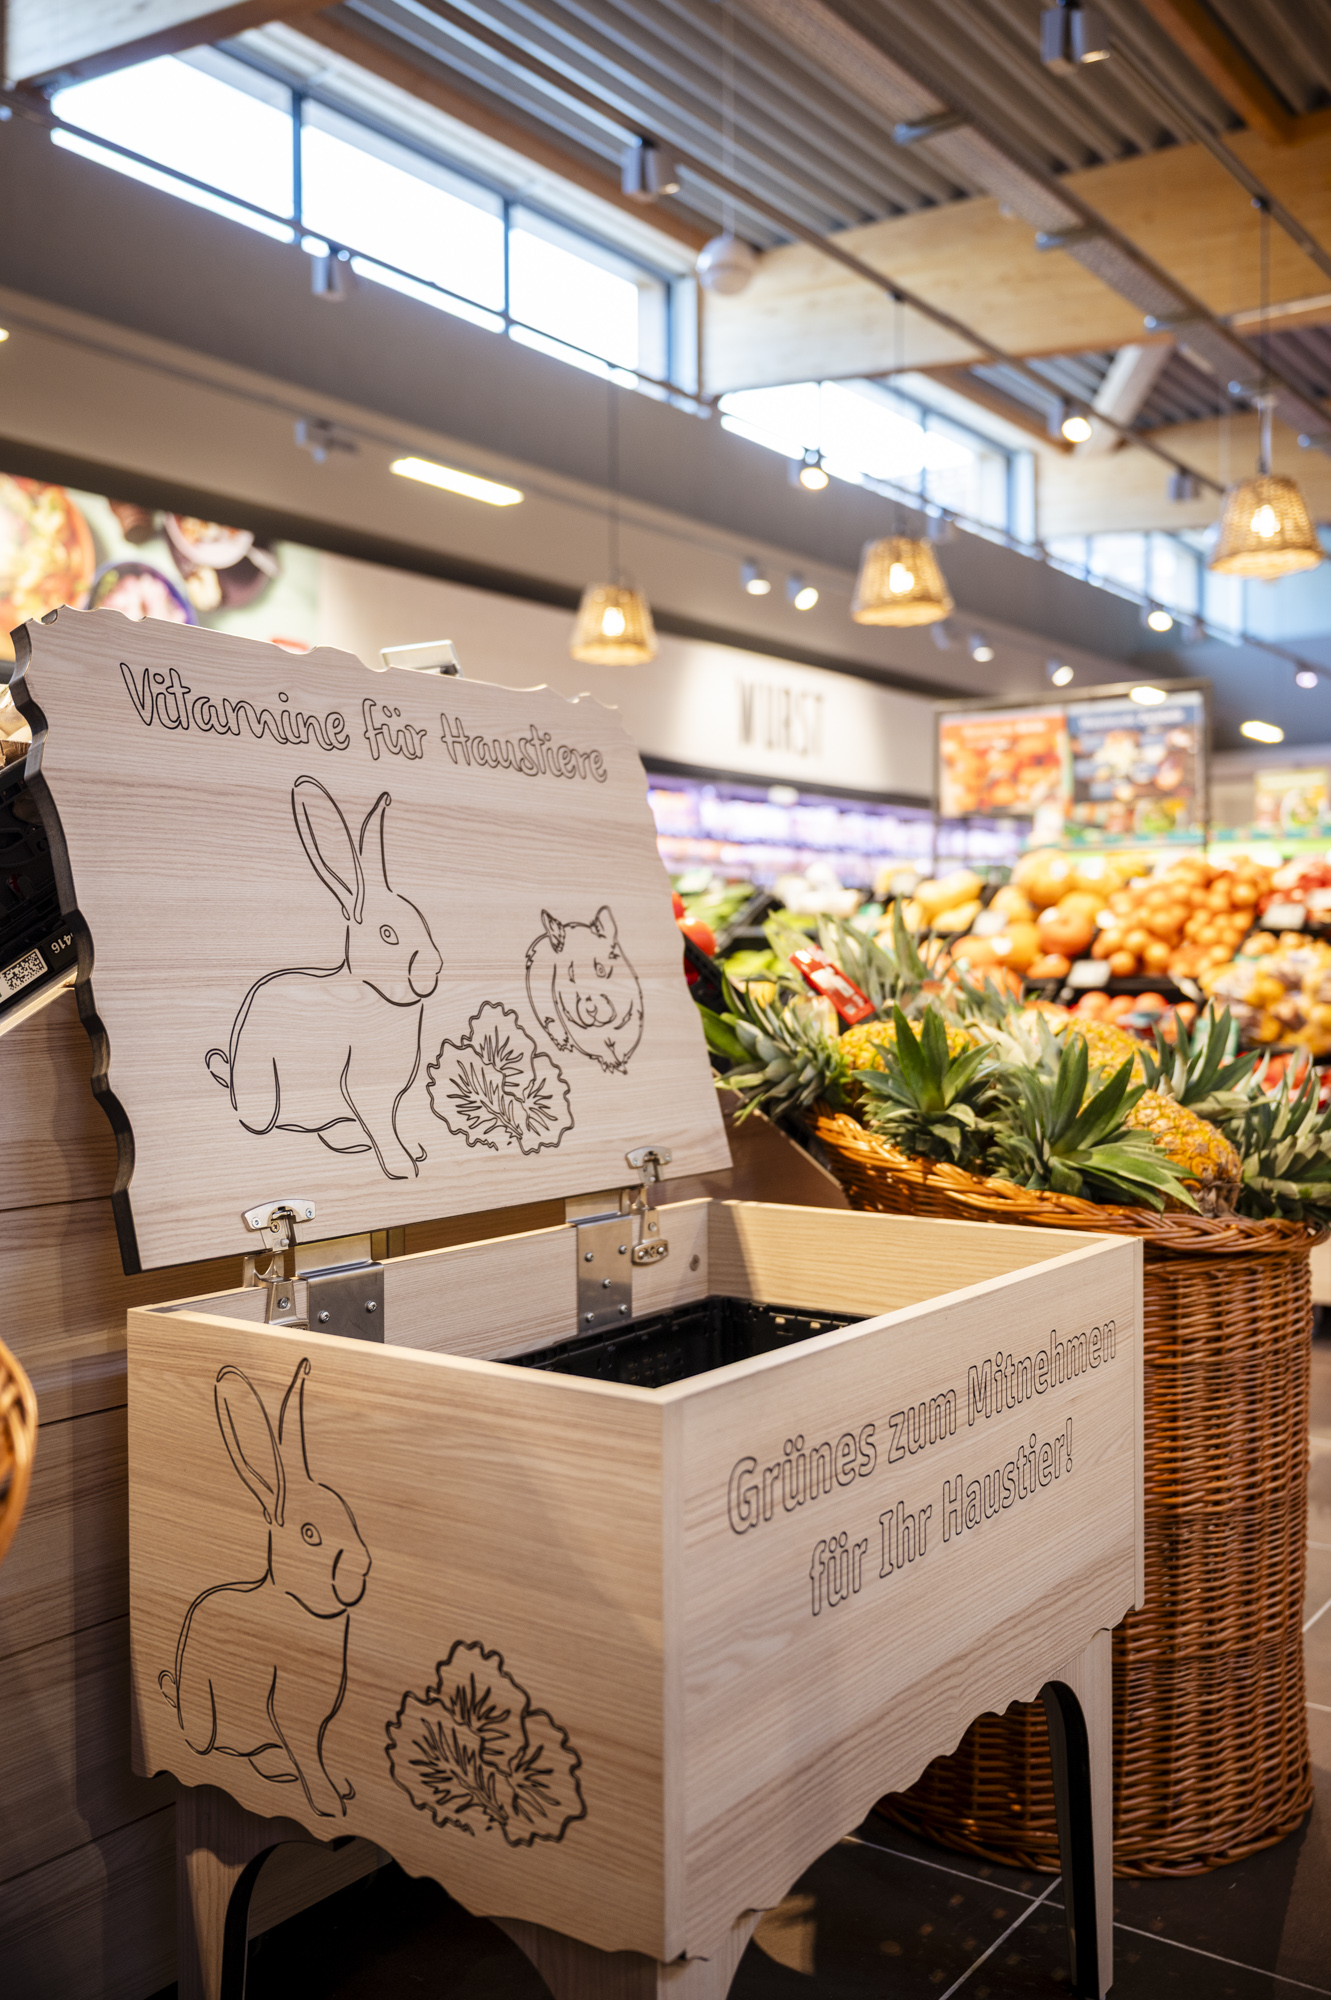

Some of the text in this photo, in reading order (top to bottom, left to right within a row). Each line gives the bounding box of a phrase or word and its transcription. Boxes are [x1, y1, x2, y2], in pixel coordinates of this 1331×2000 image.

[120, 662, 607, 783] Vitamine für Haustiere
[50, 932, 73, 954] 416
[727, 1319, 1117, 1535] Grünes zum Mitnehmen
[809, 1417, 1073, 1617] für Ihr Haustier!
